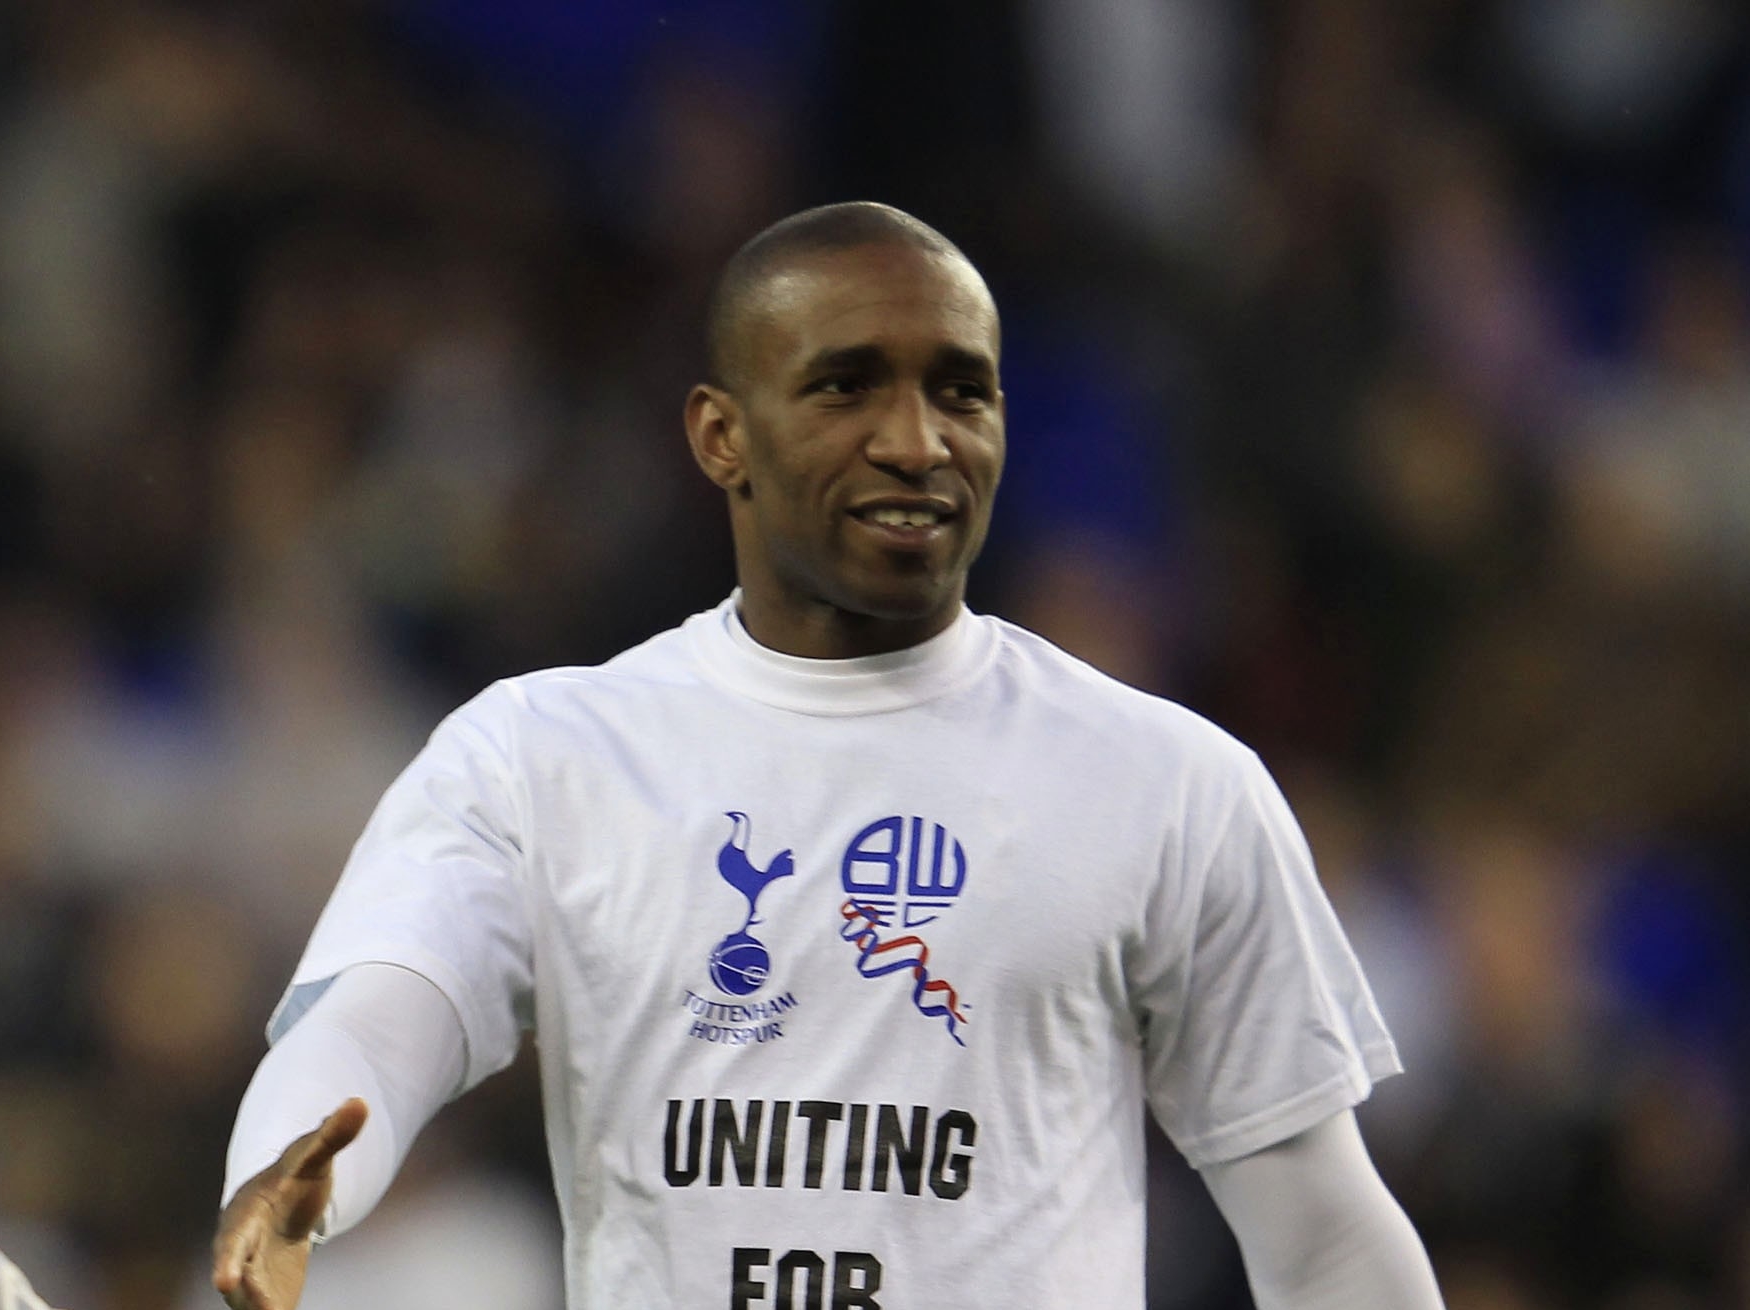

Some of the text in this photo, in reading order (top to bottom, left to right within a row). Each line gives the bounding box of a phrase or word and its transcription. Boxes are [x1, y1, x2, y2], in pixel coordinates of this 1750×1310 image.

[681, 990, 799, 1024] TOTTENHAM
[688, 1020, 784, 1046] HOTSPUR
[663, 1098, 978, 1201] UNITING
